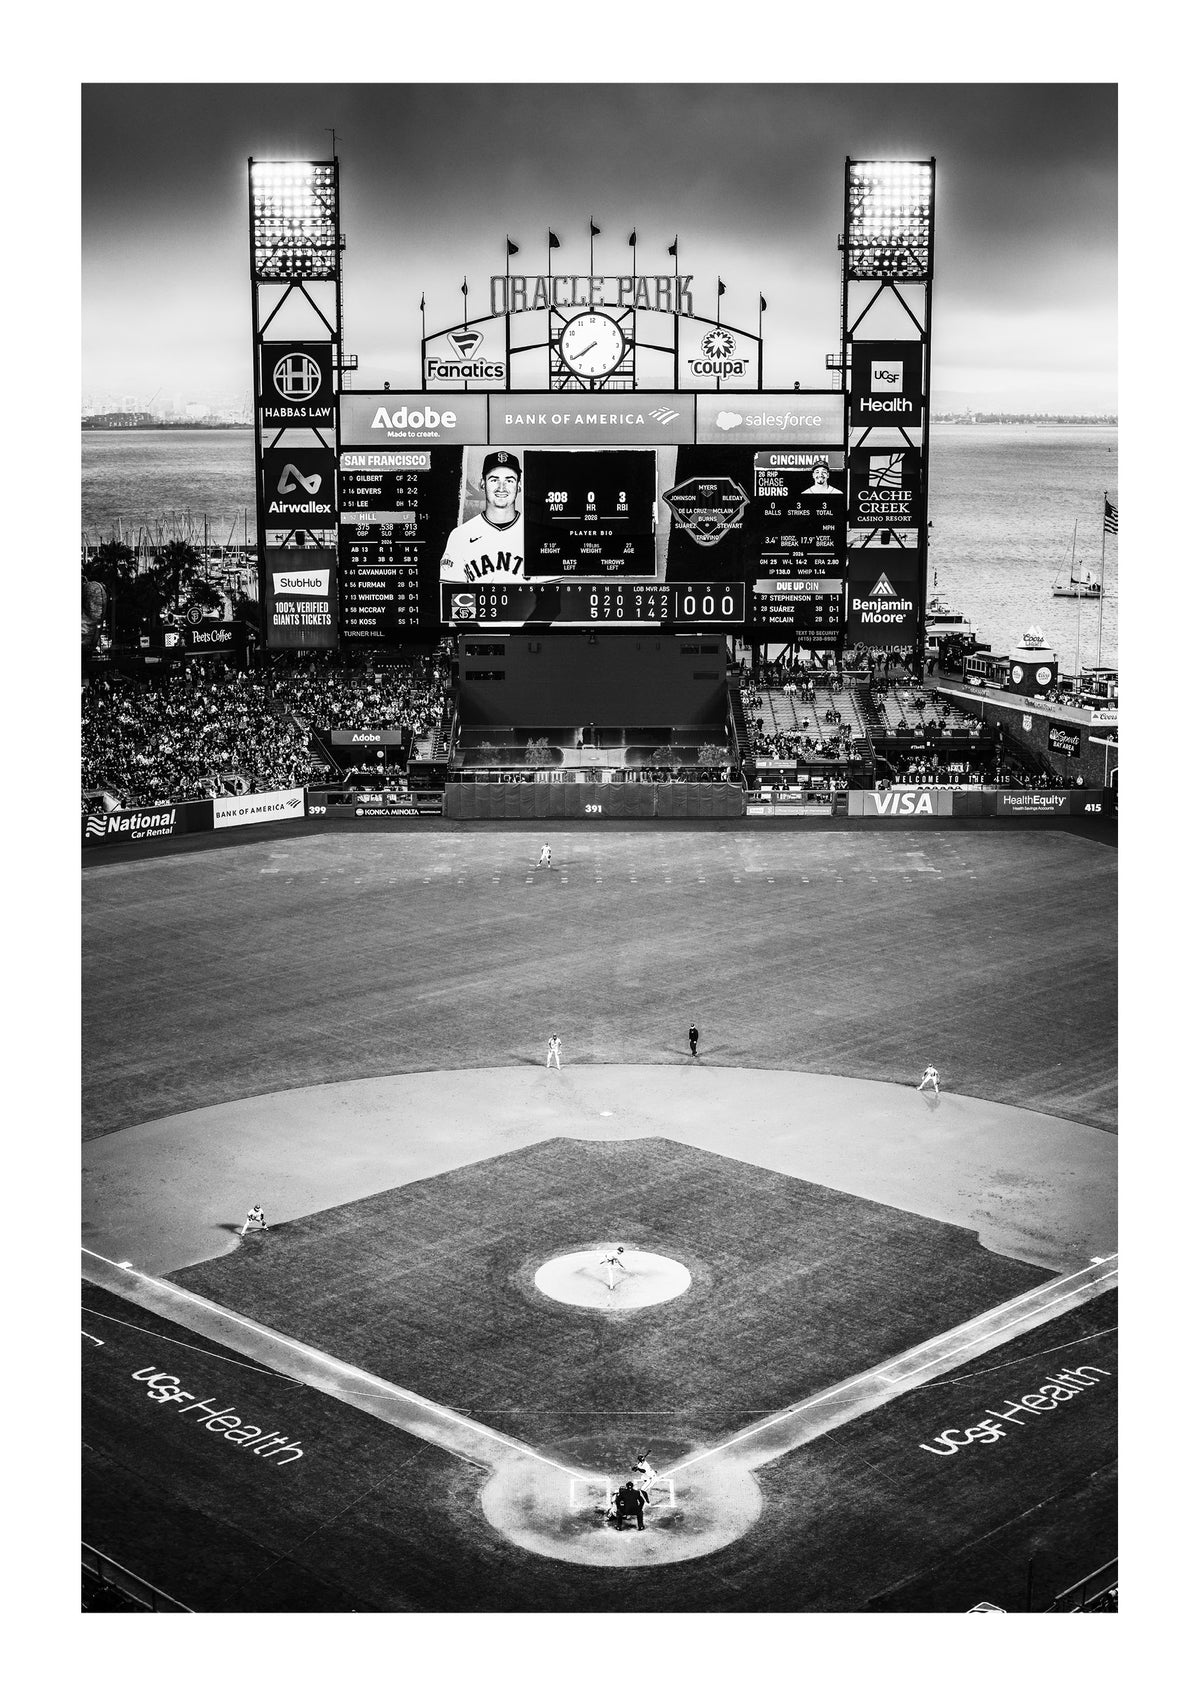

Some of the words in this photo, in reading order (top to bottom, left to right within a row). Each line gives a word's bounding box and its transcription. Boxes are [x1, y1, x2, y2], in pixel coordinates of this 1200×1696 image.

[490, 275, 604, 317] ORACLE
[616, 275, 694, 317] PARK
[428, 361, 504, 377] Fanatics
[694, 362, 743, 378] coupa
[875, 371, 899, 383] UCSF
[860, 398, 912, 411] Health
[265, 408, 306, 417] HABBAS
[309, 408, 330, 417] LAW
[371, 407, 456, 428] Adobe
[505, 414, 547, 424] BANK
[552, 414, 570, 424] OF
[575, 414, 645, 424] AMERICA
[745, 412, 822, 429] salesforce
[345, 455, 365, 465] SAN
[368, 455, 426, 465] FRANCISCO
[770, 455, 828, 465] CINCINNATI
[759, 478, 784, 486] CHASE
[759, 487, 788, 496] BURNS
[858, 491, 912, 500] CACHE
[545, 492, 568, 503] .308
[587, 492, 595, 503] 0
[619, 492, 626, 503] 3
[268, 501, 331, 513] Airwallex
[859, 502, 910, 513] CREEK
[280, 578, 322, 587] StubHub
[777, 582, 792, 590] DUE
[794, 582, 804, 590] UP
[806, 582, 819, 590] CIN
[480, 595, 486, 605] 0
[490, 595, 496, 605] 0
[501, 595, 507, 605] 0
[590, 595, 598, 606] 0
[604, 595, 610, 606] 2
[617, 595, 623, 606] 0
[636, 595, 642, 606] 3
[648, 595, 655, 606] 4
[661, 595, 668, 606] 2
[684, 596, 695, 615] 0
[703, 596, 714, 615] 0
[722, 596, 733, 615] 0
[853, 598, 912, 613] Benjamin
[275, 602, 295, 613] 100%
[297, 602, 328, 613] VERIFIED
[480, 608, 486, 618] 2
[491, 608, 497, 618] 3
[590, 607, 598, 618] 5
[604, 608, 610, 618] 7
[617, 608, 623, 618] 0
[648, 608, 655, 618] 4
[661, 608, 668, 618] 2
[273, 614, 300, 625] GIANTS
[301, 614, 331, 625] TICKETS
[861, 612, 903, 623] Moore
[211, 629, 232, 642] Coffee
[1023, 634, 1044, 643] Coors
[886, 645, 913, 653] LIGHT
[1058, 731, 1079, 745] Sports
[1062, 743, 1074, 751] AREA
[868, 793, 933, 814] VISA
[1003, 795, 1064, 806] HealthEquity
[216, 810, 237, 819] BANK
[239, 808, 250, 816] OF
[250, 804, 285, 814] AMERICA
[309, 806, 326, 814] 399
[585, 805, 602, 813] 391
[1084, 804, 1101, 812] 415
[108, 809, 176, 833] National
[131, 831, 145, 839] Car
[147, 826, 173, 837] Rental
[132, 1366, 195, 1403] UCSF
[178, 1398, 304, 1465] Health
[919, 1419, 1007, 1455] UCSF
[985, 1366, 1112, 1425] Health
